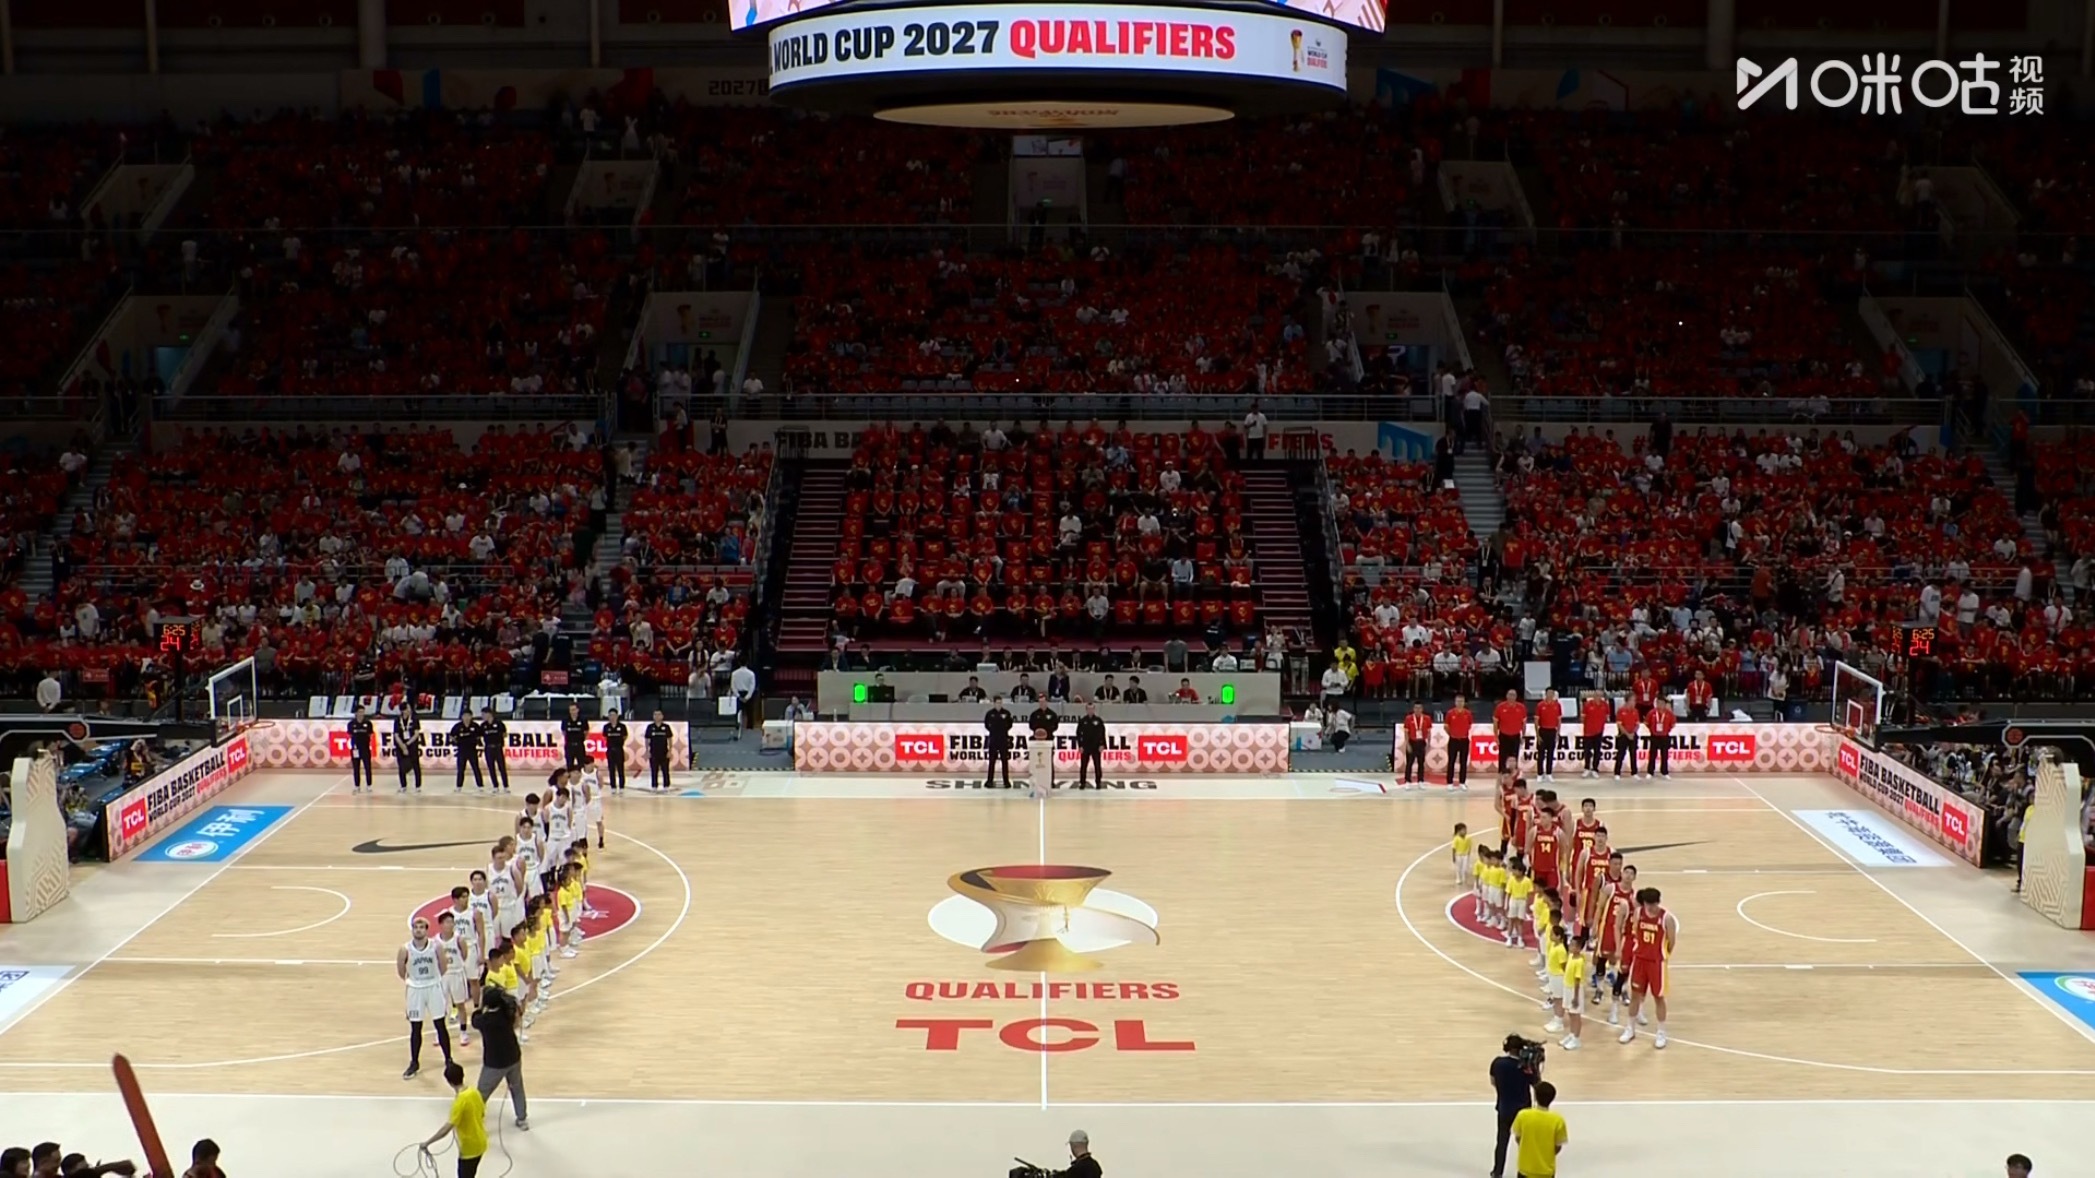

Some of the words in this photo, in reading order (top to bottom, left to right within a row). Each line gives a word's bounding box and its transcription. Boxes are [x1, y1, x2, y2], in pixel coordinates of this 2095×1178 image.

[774, 33, 828, 73] WORLD
[835, 26, 895, 62] CUP
[904, 21, 999, 56] 2027
[1010, 20, 1235, 59] QUALIFIERS
[1909, 639, 1930, 656] 24
[229, 747, 246, 765] TCL
[900, 741, 939, 754] TCL
[1143, 742, 1182, 755] TCL
[1713, 741, 1750, 755] TCL
[1841, 749, 1857, 770] TCL
[147, 784, 170, 811] FIBA
[170, 752, 226, 796] BASKETBALL
[1860, 754, 1880, 781] FIBA
[1881, 766, 1940, 816] BASKETBALL
[124, 809, 145, 830] TCL
[1944, 811, 1965, 836] TCL
[412, 956, 434, 967] JAPAN
[905, 982, 1180, 1001] QUALIFIERS
[895, 1018, 1196, 1052] TCL
